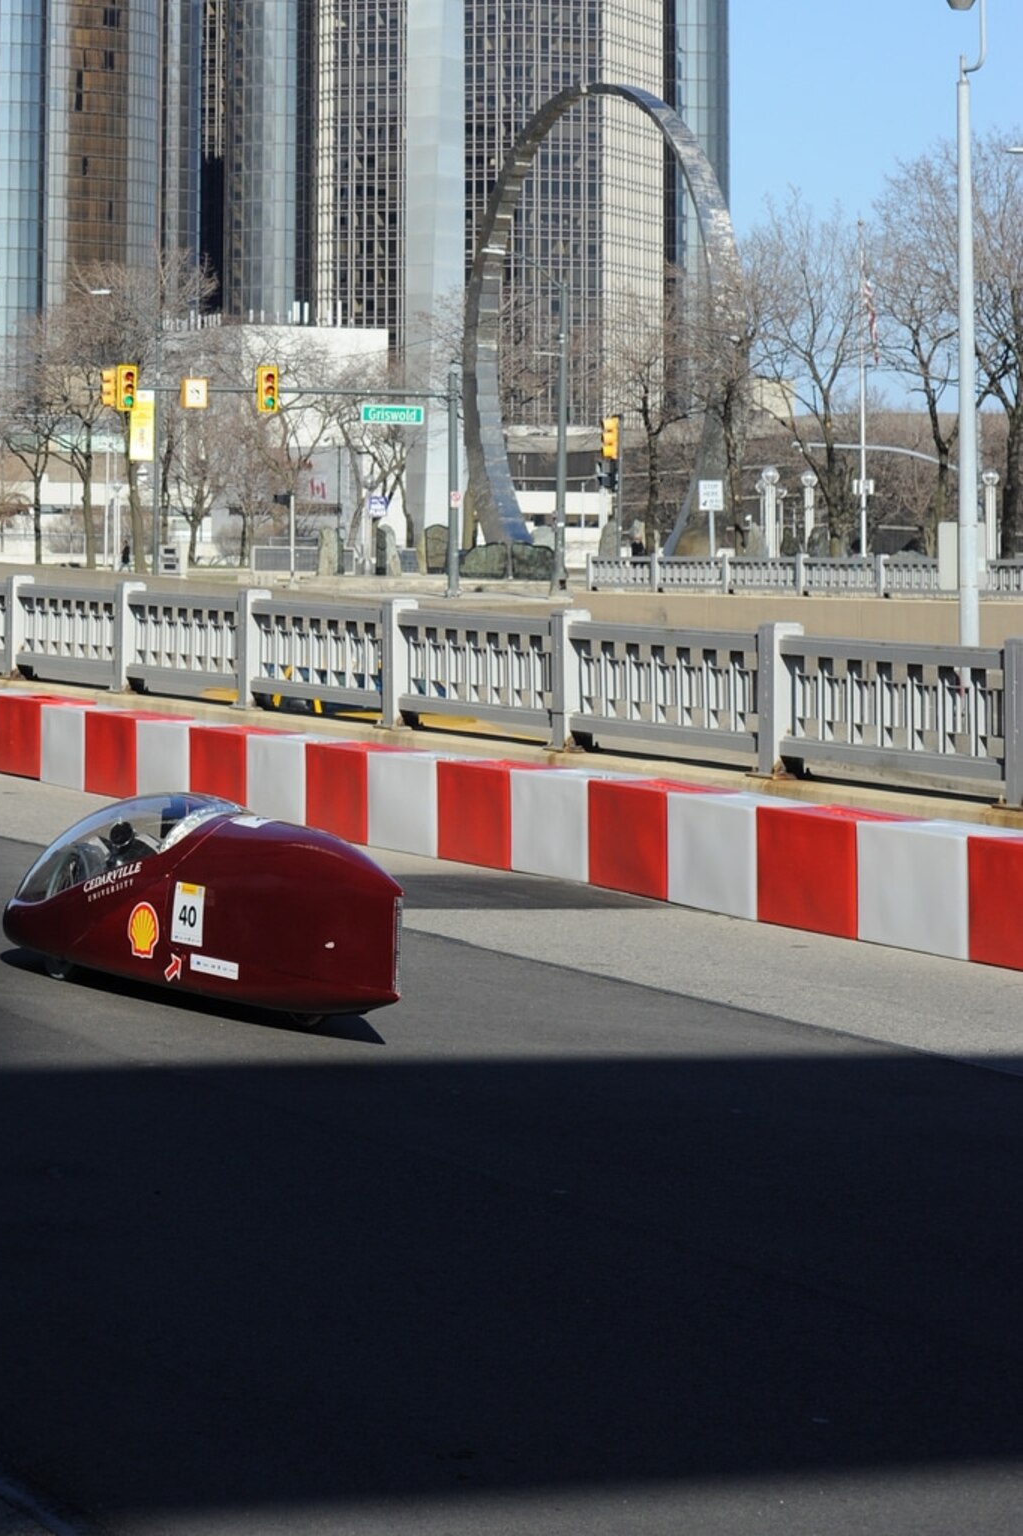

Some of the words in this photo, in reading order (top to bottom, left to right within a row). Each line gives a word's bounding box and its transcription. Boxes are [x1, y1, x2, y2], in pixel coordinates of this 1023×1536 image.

[368, 408, 416, 421] Griswold
[83, 861, 142, 892] CEDARVILLE
[88, 878, 133, 902] UNIVERSITY
[178, 904, 197, 928] 40
